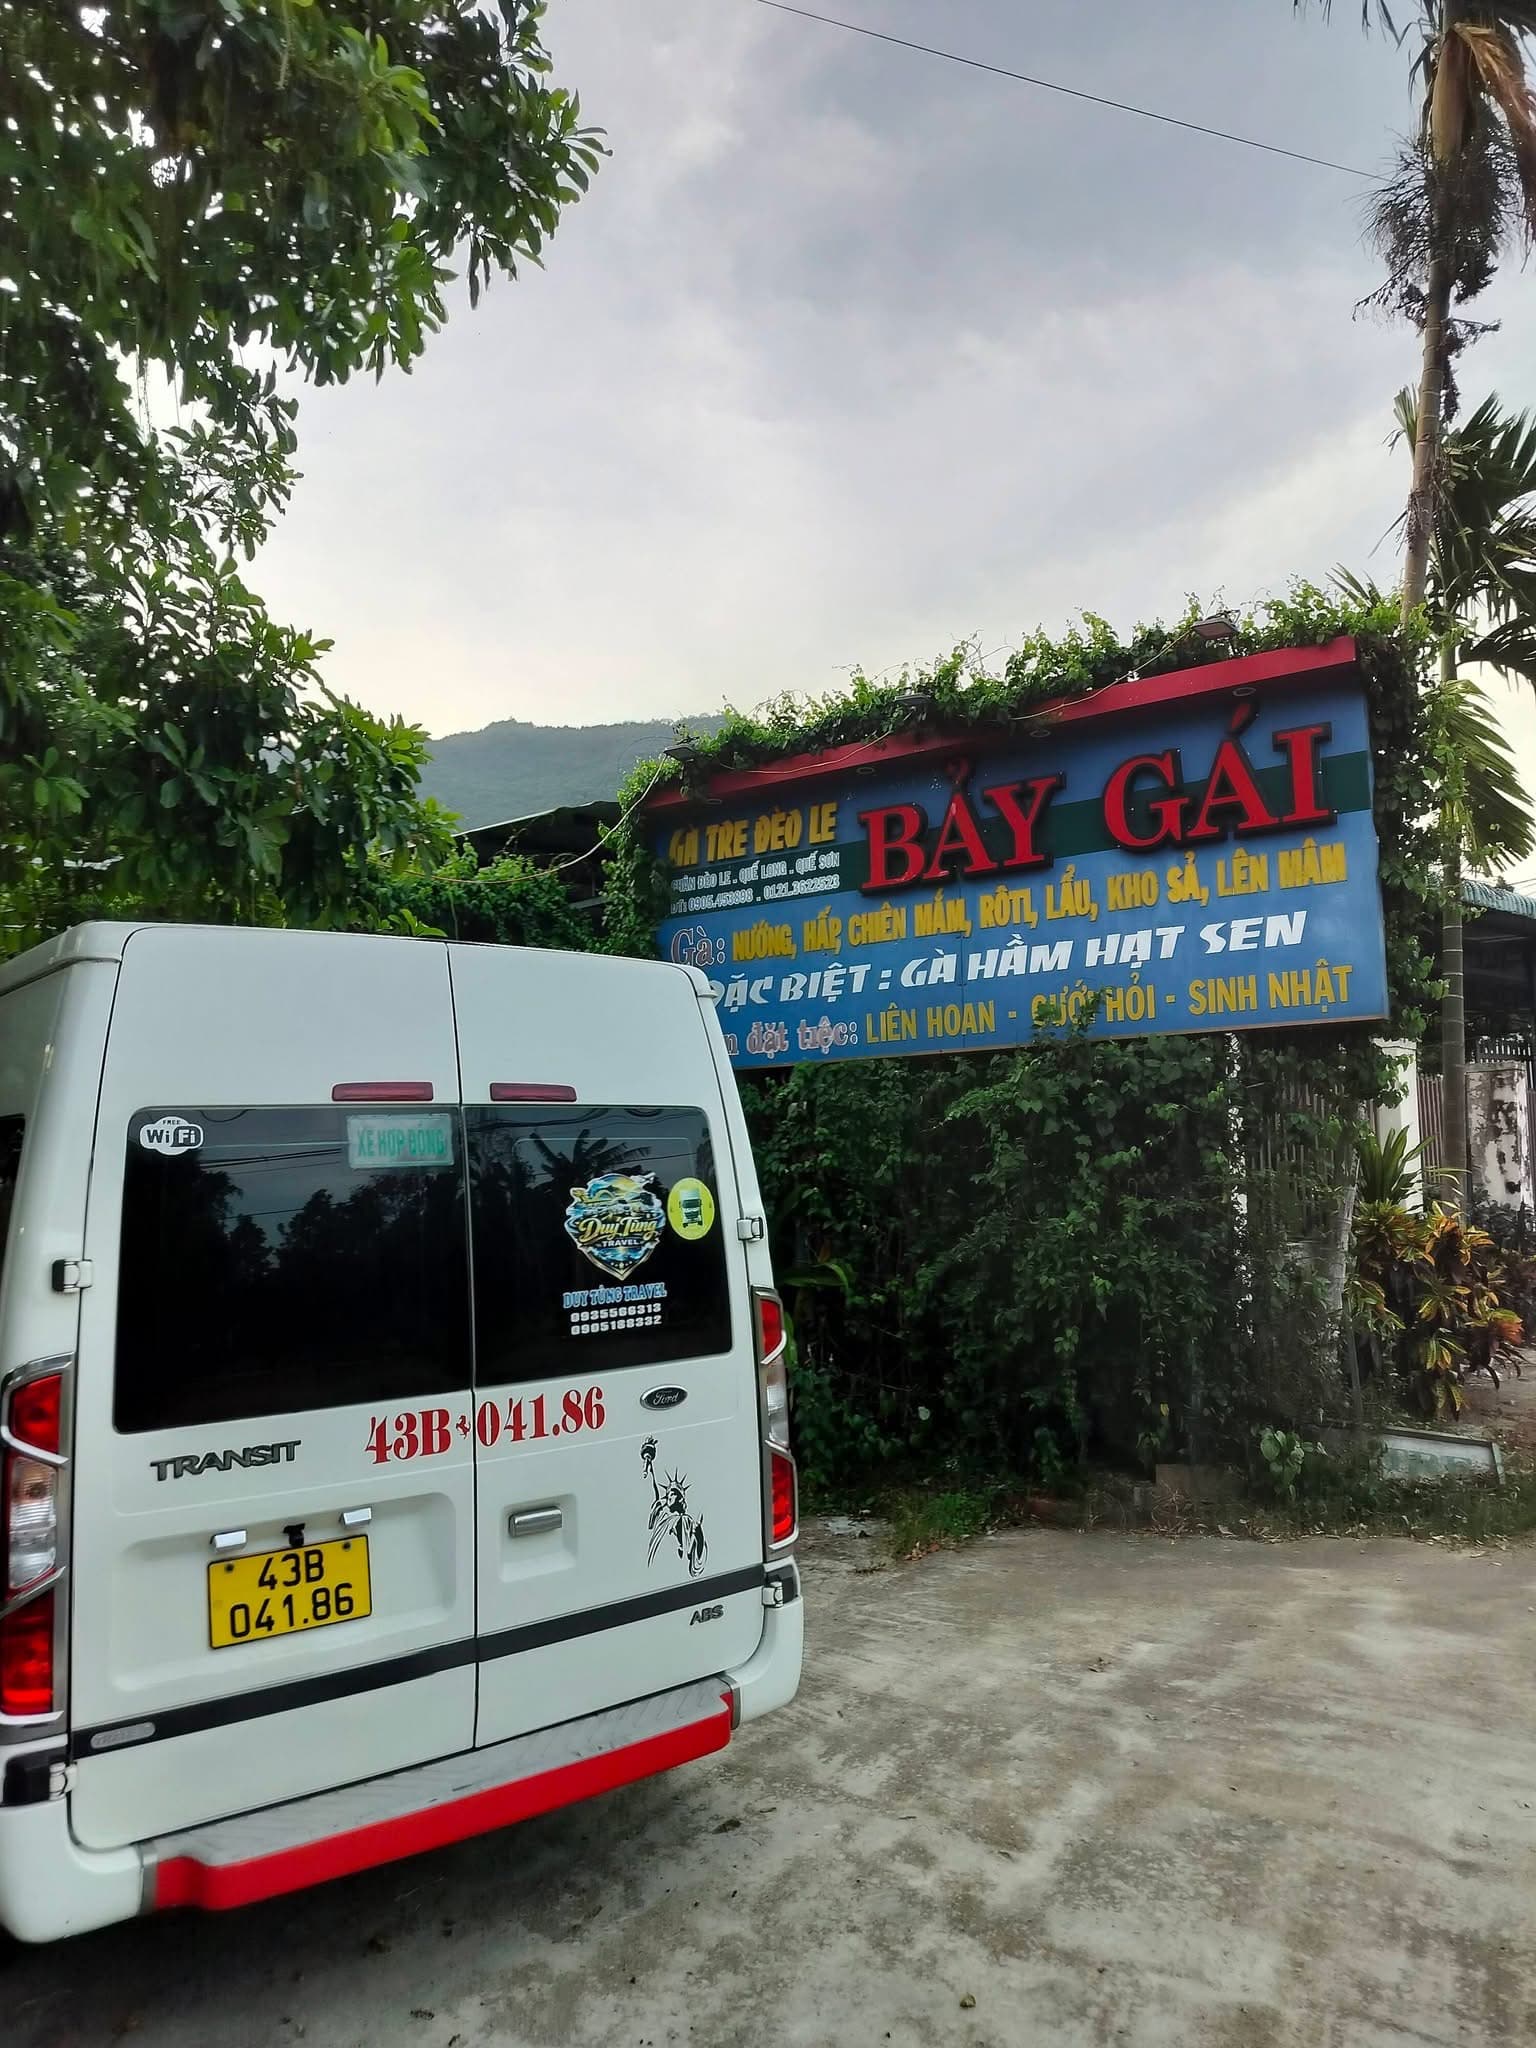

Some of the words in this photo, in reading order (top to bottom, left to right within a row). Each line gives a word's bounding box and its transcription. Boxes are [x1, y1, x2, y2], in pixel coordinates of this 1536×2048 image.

[858, 760, 1064, 891] BẢY
[1104, 704, 1334, 850] GÁI
[707, 820, 748, 861] TRE
[754, 805, 802, 853] ĐÈO
[809, 802, 837, 844] LE
[761, 861, 786, 880] LONG
[671, 926, 726, 966] Gà:
[733, 920, 797, 961] NƯỚNG,
[804, 905, 842, 955] HẤP,
[848, 902, 907, 946] CHIÊN
[1046, 864, 1098, 921] LẨU,
[1107, 870, 1159, 911] KHO
[1167, 851, 1209, 907] SẢ,
[1217, 847, 1269, 897] LÊN
[1278, 837, 1347, 889] MÂM
[779, 962, 872, 1003] BIỆT
[901, 948, 957, 988] GÀ
[967, 933, 1073, 981] HẦM
[1085, 926, 1186, 969] HẠT
[1199, 911, 1307, 954] SEN
[746, 1020, 789, 1059] đặt
[866, 1002, 917, 1044] LIÊN
[926, 1000, 996, 1037] HOAN
[1106, 972, 1156, 1022] HỎI
[1188, 975, 1257, 1016] SINH
[1268, 958, 1352, 1013] NHẬT
[358, 1129, 375, 1157] XE
[602, 1239, 639, 1248] TRAVEL
[563, 1291, 588, 1308] DUY
[590, 1284, 622, 1305] TÙNG
[623, 1282, 667, 1301] TRAVEL
[653, 1391, 680, 1405] Ford
[365, 1409, 452, 1464] 43B
[477, 1386, 605, 1446] 041.86
[150, 1440, 301, 1481] TRANSIT
[258, 1549, 324, 1590] 43B
[230, 1583, 354, 1638] 041.86
[689, 1605, 724, 1626] ABS
